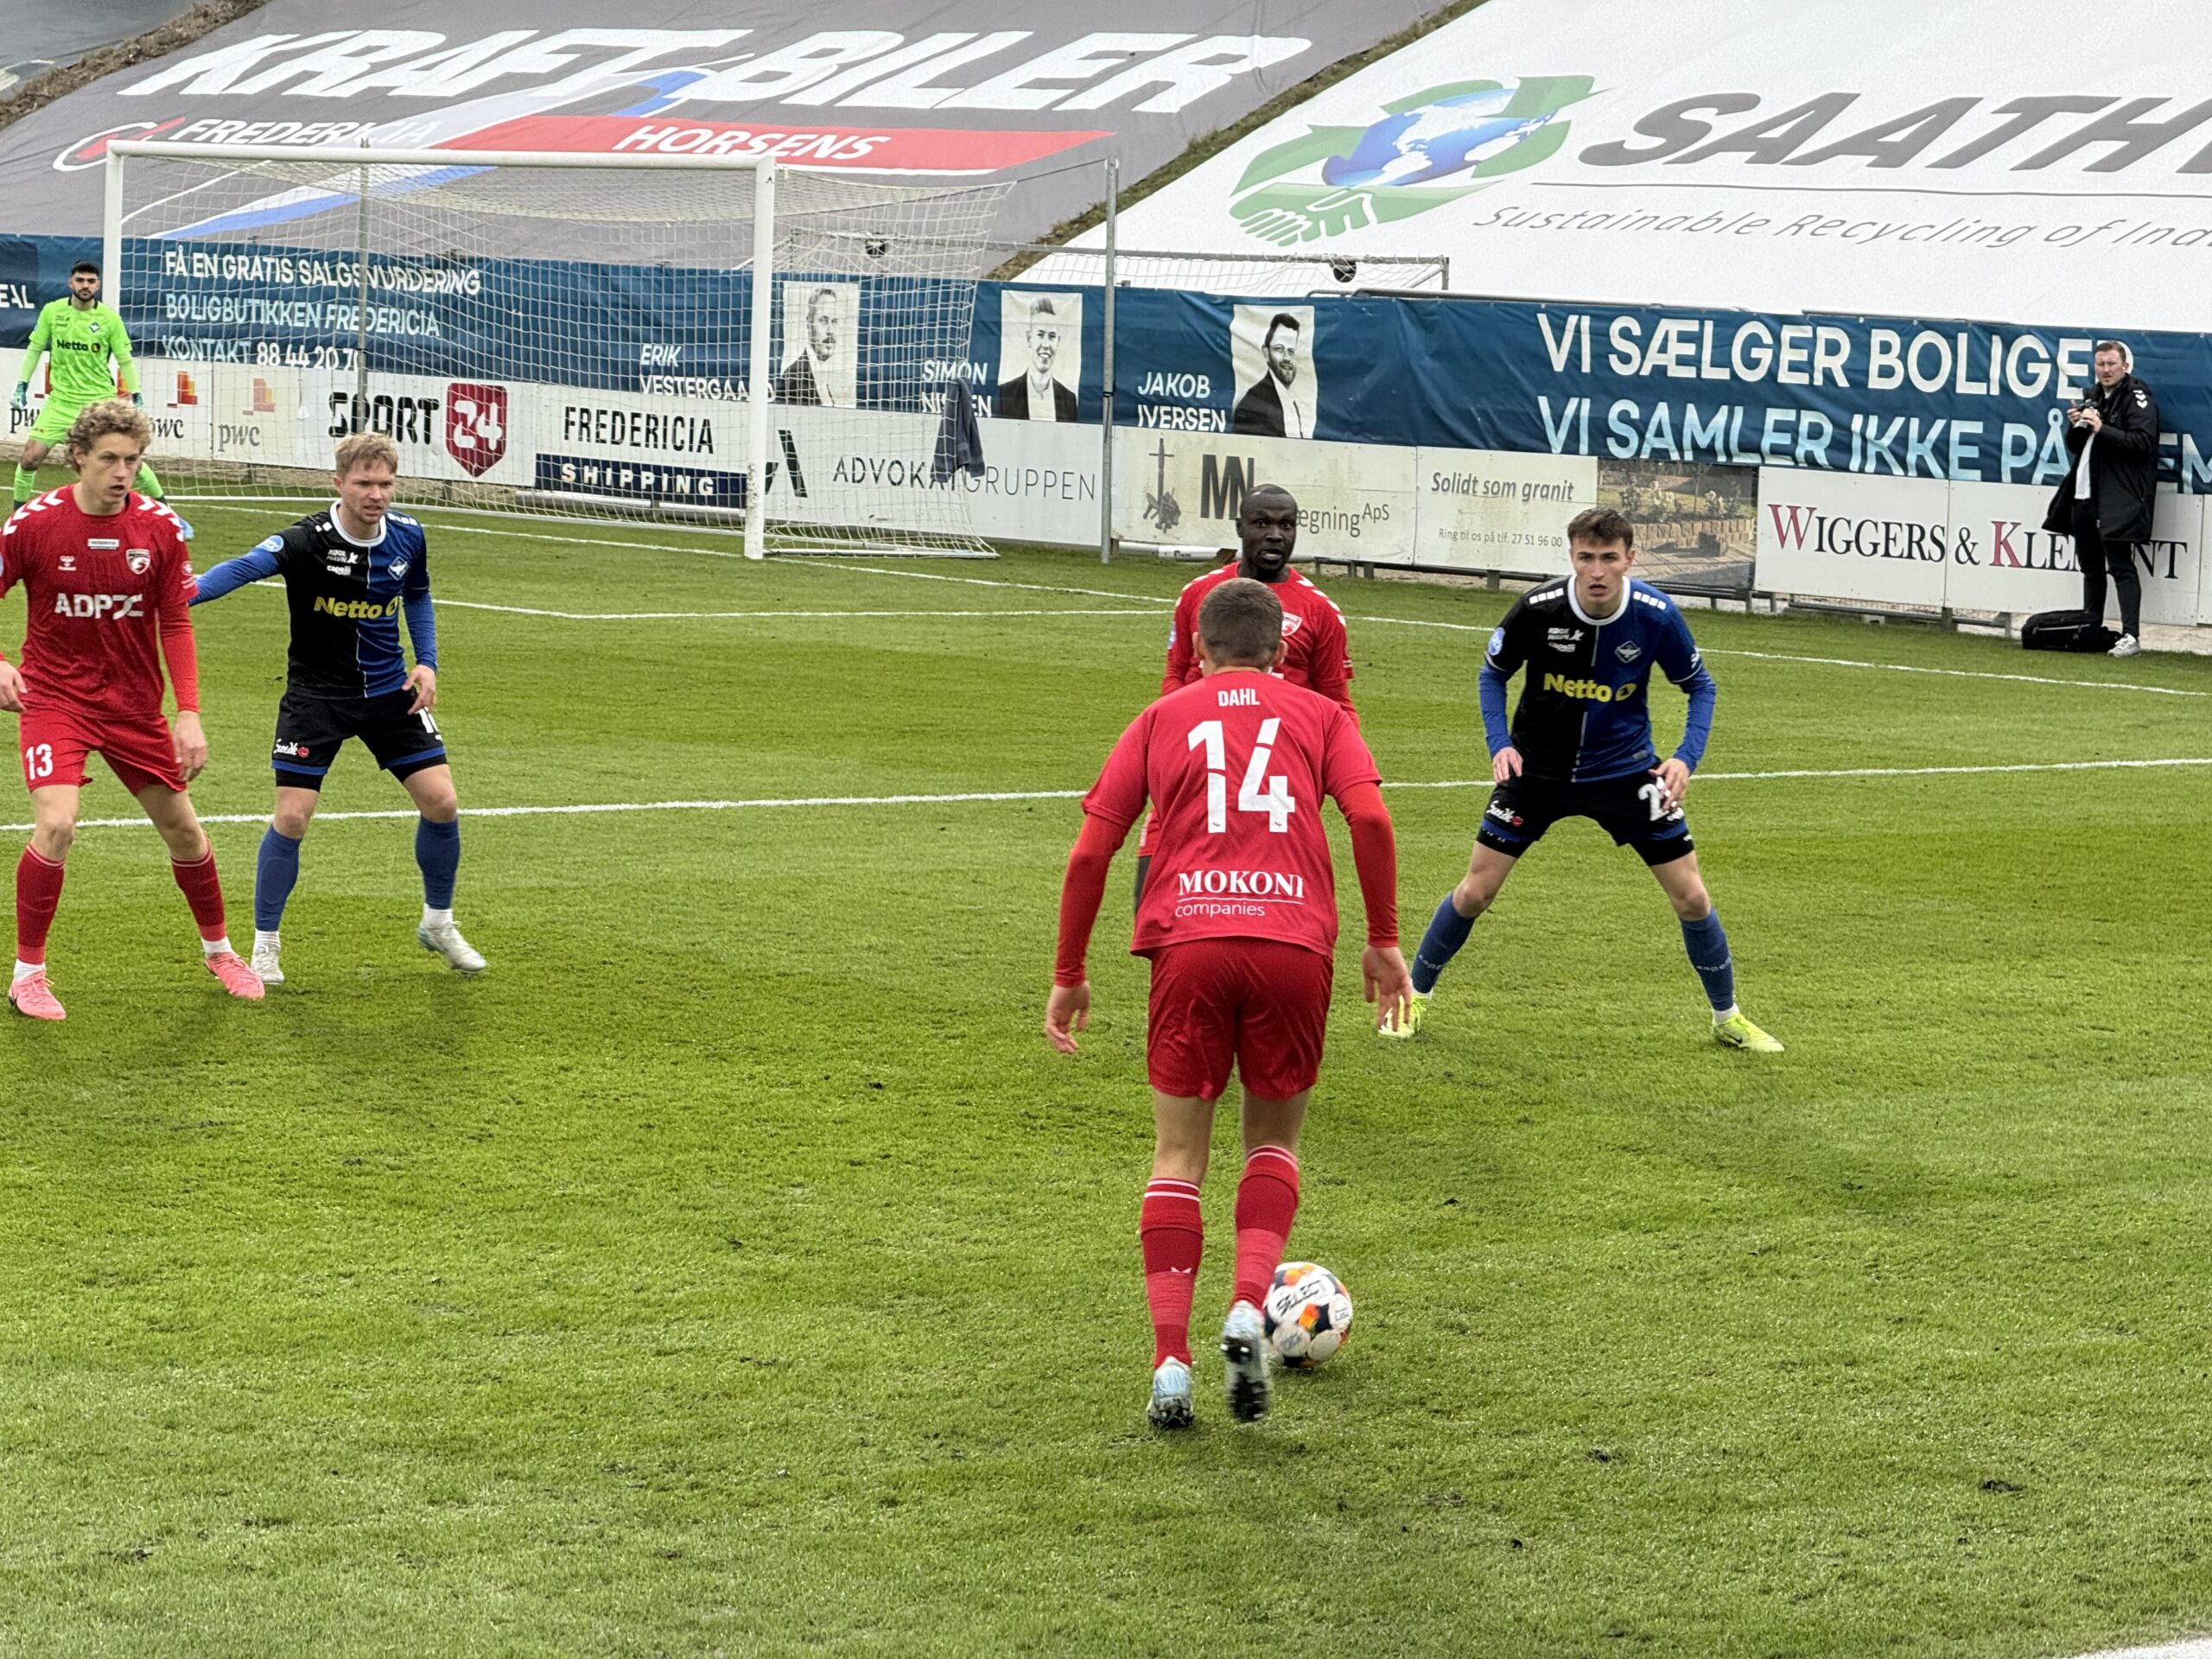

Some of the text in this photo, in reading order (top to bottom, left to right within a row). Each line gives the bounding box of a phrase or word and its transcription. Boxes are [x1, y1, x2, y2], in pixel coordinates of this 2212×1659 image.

[117, 28, 1313, 113] KRAFT BILER
[168, 118, 438, 146] FREDERICIA
[611, 124, 891, 160] HORSENS
[1472, 206, 1771, 235] Sustainable
[1773, 213, 2038, 248] Recycling
[2043, 219, 2127, 247] of
[165, 245, 481, 296] FÅ EN GRATIS SALGSVURDERING
[166, 294, 441, 337] BOLIGBUTIKKEN FREDERICIA
[56, 339, 89, 352] Netto
[162, 334, 252, 365] KONTAKT
[256, 341, 281, 367] 88
[285, 344, 311, 367] 44
[314, 346, 340, 370] 20
[639, 344, 683, 367] ERIK
[1536, 313, 1591, 373] VI
[1608, 315, 1851, 387] SÆLGER
[639, 373, 776, 404] VESTERGAAD
[922, 359, 988, 386] SIMON
[1137, 372, 1211, 398] JAKOB
[10, 407, 41, 433] pw
[328, 391, 440, 445] SPORT
[453, 398, 503, 453] 24
[563, 405, 715, 454] FREDERICIA
[1137, 405, 1227, 432] IVERSEN
[218, 422, 260, 452] pwc
[1537, 396, 1591, 455] VI
[1606, 398, 1834, 469] SAMLER
[1851, 414, 1982, 481] IKKE
[2000, 407, 2071, 486] PÅ
[561, 462, 715, 497] SHIPPING
[1431, 472, 1575, 504] Solidt som granit
[1295, 502, 1390, 538] ægning ApS
[1768, 503, 1946, 563] WIGGERS
[1955, 526, 1980, 566] &
[1439, 528, 1459, 542] Ring
[1471, 532, 1482, 542] os
[1484, 531, 1495, 544] på
[1512, 533, 1522, 545] 27
[1524, 535, 1535, 545] 51
[1537, 536, 1549, 547] 96
[1551, 537, 1563, 548] 00
[314, 595, 383, 619] Netto
[1217, 688, 1261, 708] DAHL
[1543, 672, 1613, 702] Netto
[25, 743, 54, 780] 13
[1187, 716, 1296, 834] 14
[1177, 869, 1305, 899] MOKONI
[1174, 901, 1266, 918] companies
